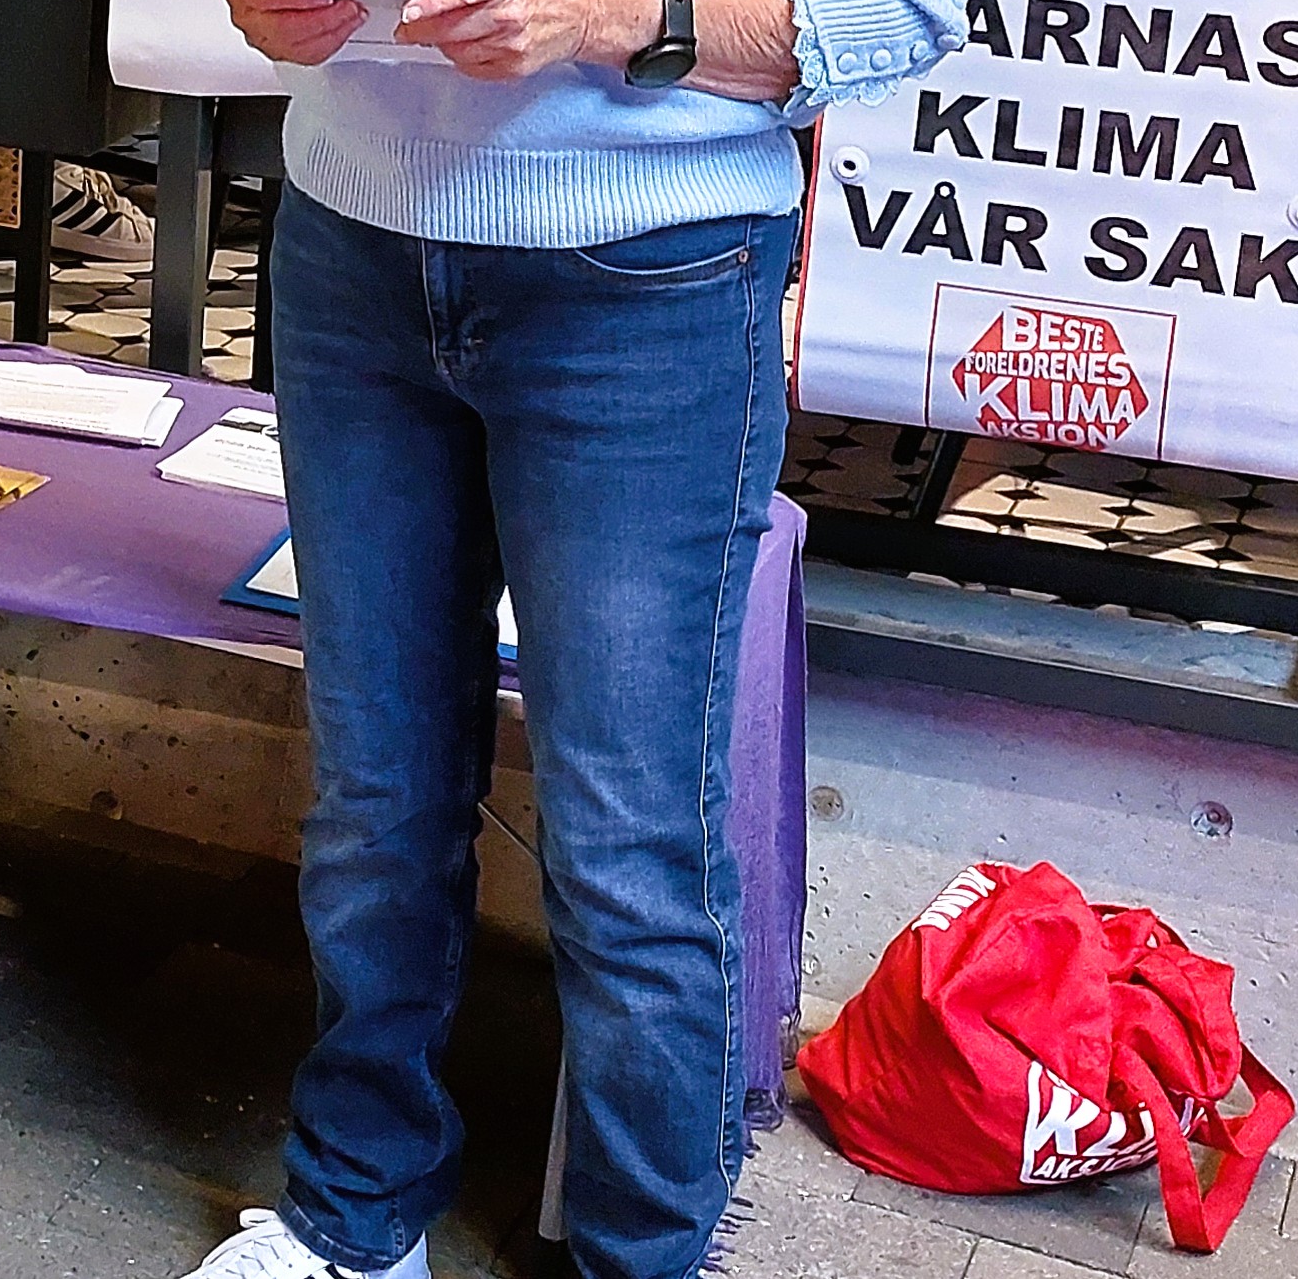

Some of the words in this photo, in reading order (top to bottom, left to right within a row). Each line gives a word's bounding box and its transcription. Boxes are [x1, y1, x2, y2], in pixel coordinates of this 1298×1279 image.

[912, 89, 1257, 191] KLIMA
[841, 181, 1049, 273] VÅR
[1084, 216, 1298, 304] SAK
[1001, 305, 1104, 352] BESTE
[963, 350, 1133, 388] FORELDRENES
[964, 372, 1138, 424] KLIMA
[981, 420, 1124, 448] AKSJON
